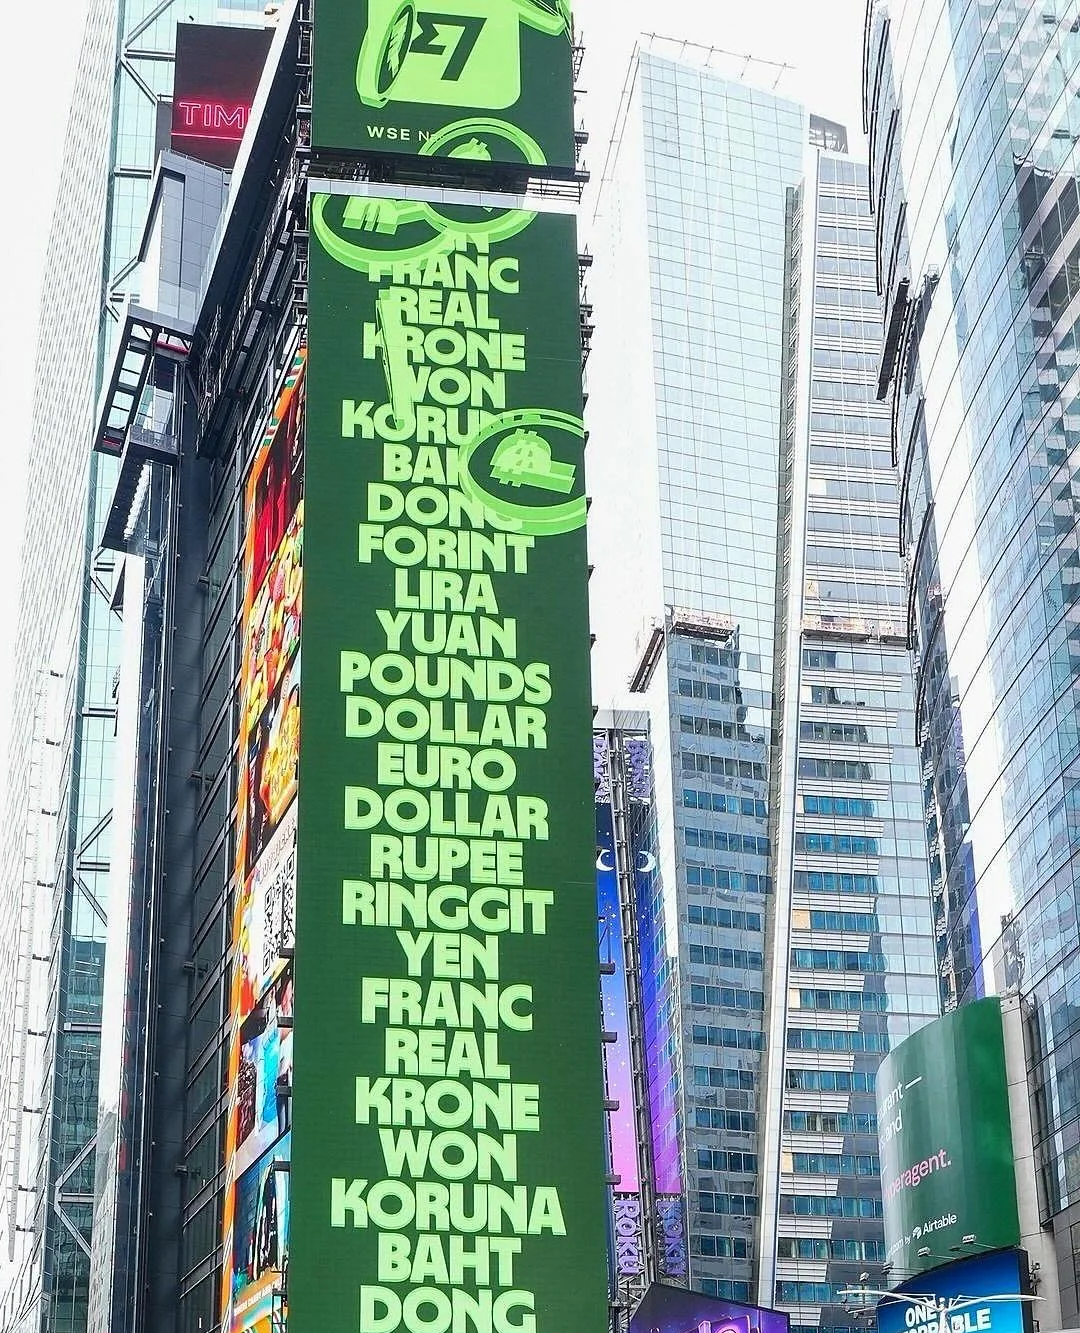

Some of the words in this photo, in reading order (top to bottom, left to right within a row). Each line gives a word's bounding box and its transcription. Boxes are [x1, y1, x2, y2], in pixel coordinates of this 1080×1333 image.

[179, 102, 250, 129] TIM
[367, 126, 410, 140] WSE
[389, 286, 499, 330] REAL
[341, 400, 498, 446] KORU
[383, 443, 460, 485] BA
[358, 523, 535, 573] FORINT
[395, 568, 498, 615] LIRA
[376, 609, 516, 658] YUAN
[340, 650, 551, 700] POUNDS
[344, 697, 548, 749] DOLLAR
[377, 742, 516, 791] EURO
[344, 786, 550, 841] DOLLAR
[369, 834, 524, 885] RUPEE
[342, 880, 554, 935] RINGGIT
[395, 930, 499, 980] YEN
[361, 977, 534, 1032] FRANC
[384, 1027, 511, 1080] REAL
[355, 1076, 540, 1131] KRONE
[378, 1127, 517, 1181] WON
[330, 1178, 567, 1236] KORUNA
[923, 1212, 958, 1235] Airtable
[377, 1234, 522, 1286] BAHT
[905, 1299, 938, 1328] ONE
